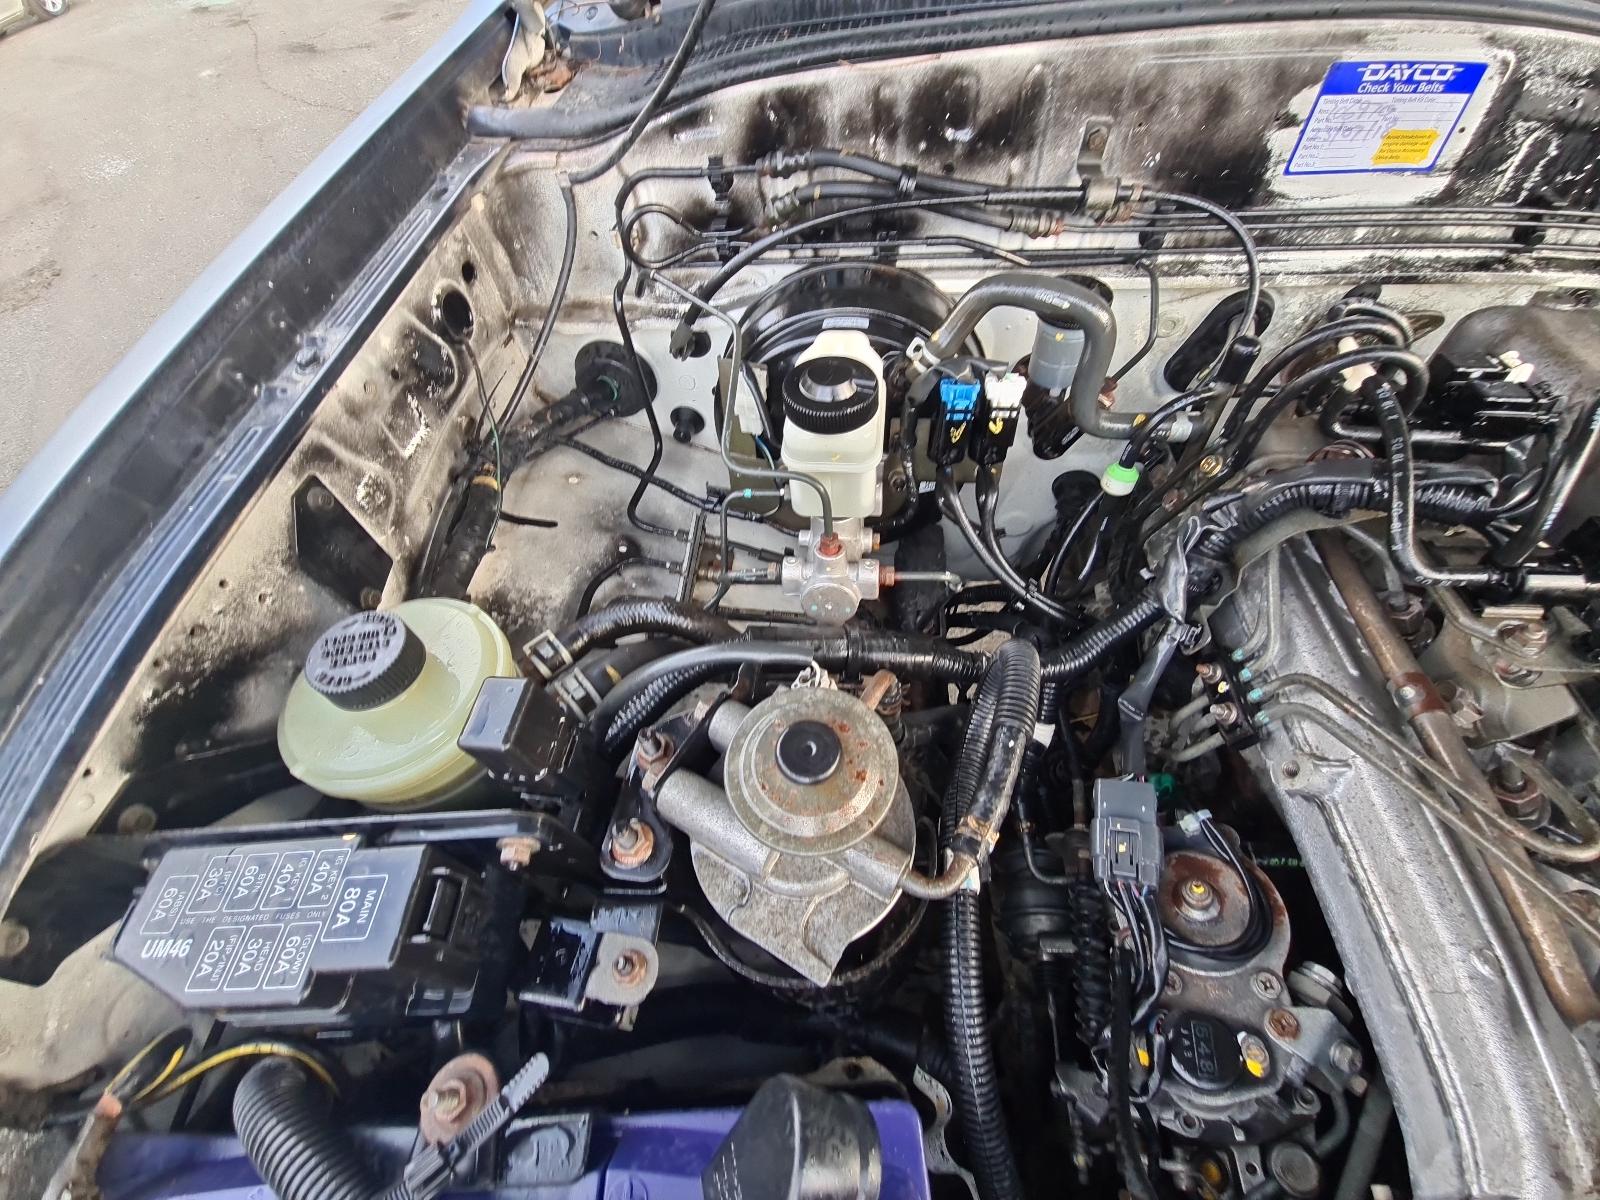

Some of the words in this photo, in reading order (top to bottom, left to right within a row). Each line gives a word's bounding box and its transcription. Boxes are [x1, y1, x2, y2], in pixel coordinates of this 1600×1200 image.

[1357, 64, 1464, 80] DAYCO
[1357, 82, 1390, 93] Check
[1392, 82, 1417, 92] Your
[1417, 82, 1445, 92] Belts
[298, 857, 309, 867] IG
[335, 855, 344, 865] IG
[195, 868, 223, 901] 30A
[214, 870, 233, 896] (PTC)
[233, 865, 259, 899] 60A
[252, 873, 266, 894] BTN
[270, 863, 294, 897] 40A
[289, 872, 302, 891] KEY
[307, 861, 330, 895] 40A
[326, 870, 338, 889] KEY
[150, 887, 178, 921] 60A
[169, 891, 185, 917] (ABS)
[223, 914, 270, 923] DESIGNATED
[275, 911, 300, 920] FUSES
[307, 910, 326, 918] ONLY
[331, 887, 361, 930] 80A
[356, 889, 377, 924] MAIN
[141, 939, 193, 958] UM46
[196, 939, 225, 978] 20A
[234, 938, 263, 976] 30A
[254, 941, 273, 972] HEAD
[273, 936, 300, 975] 60A
[290, 934, 312, 975] (GLOW)
